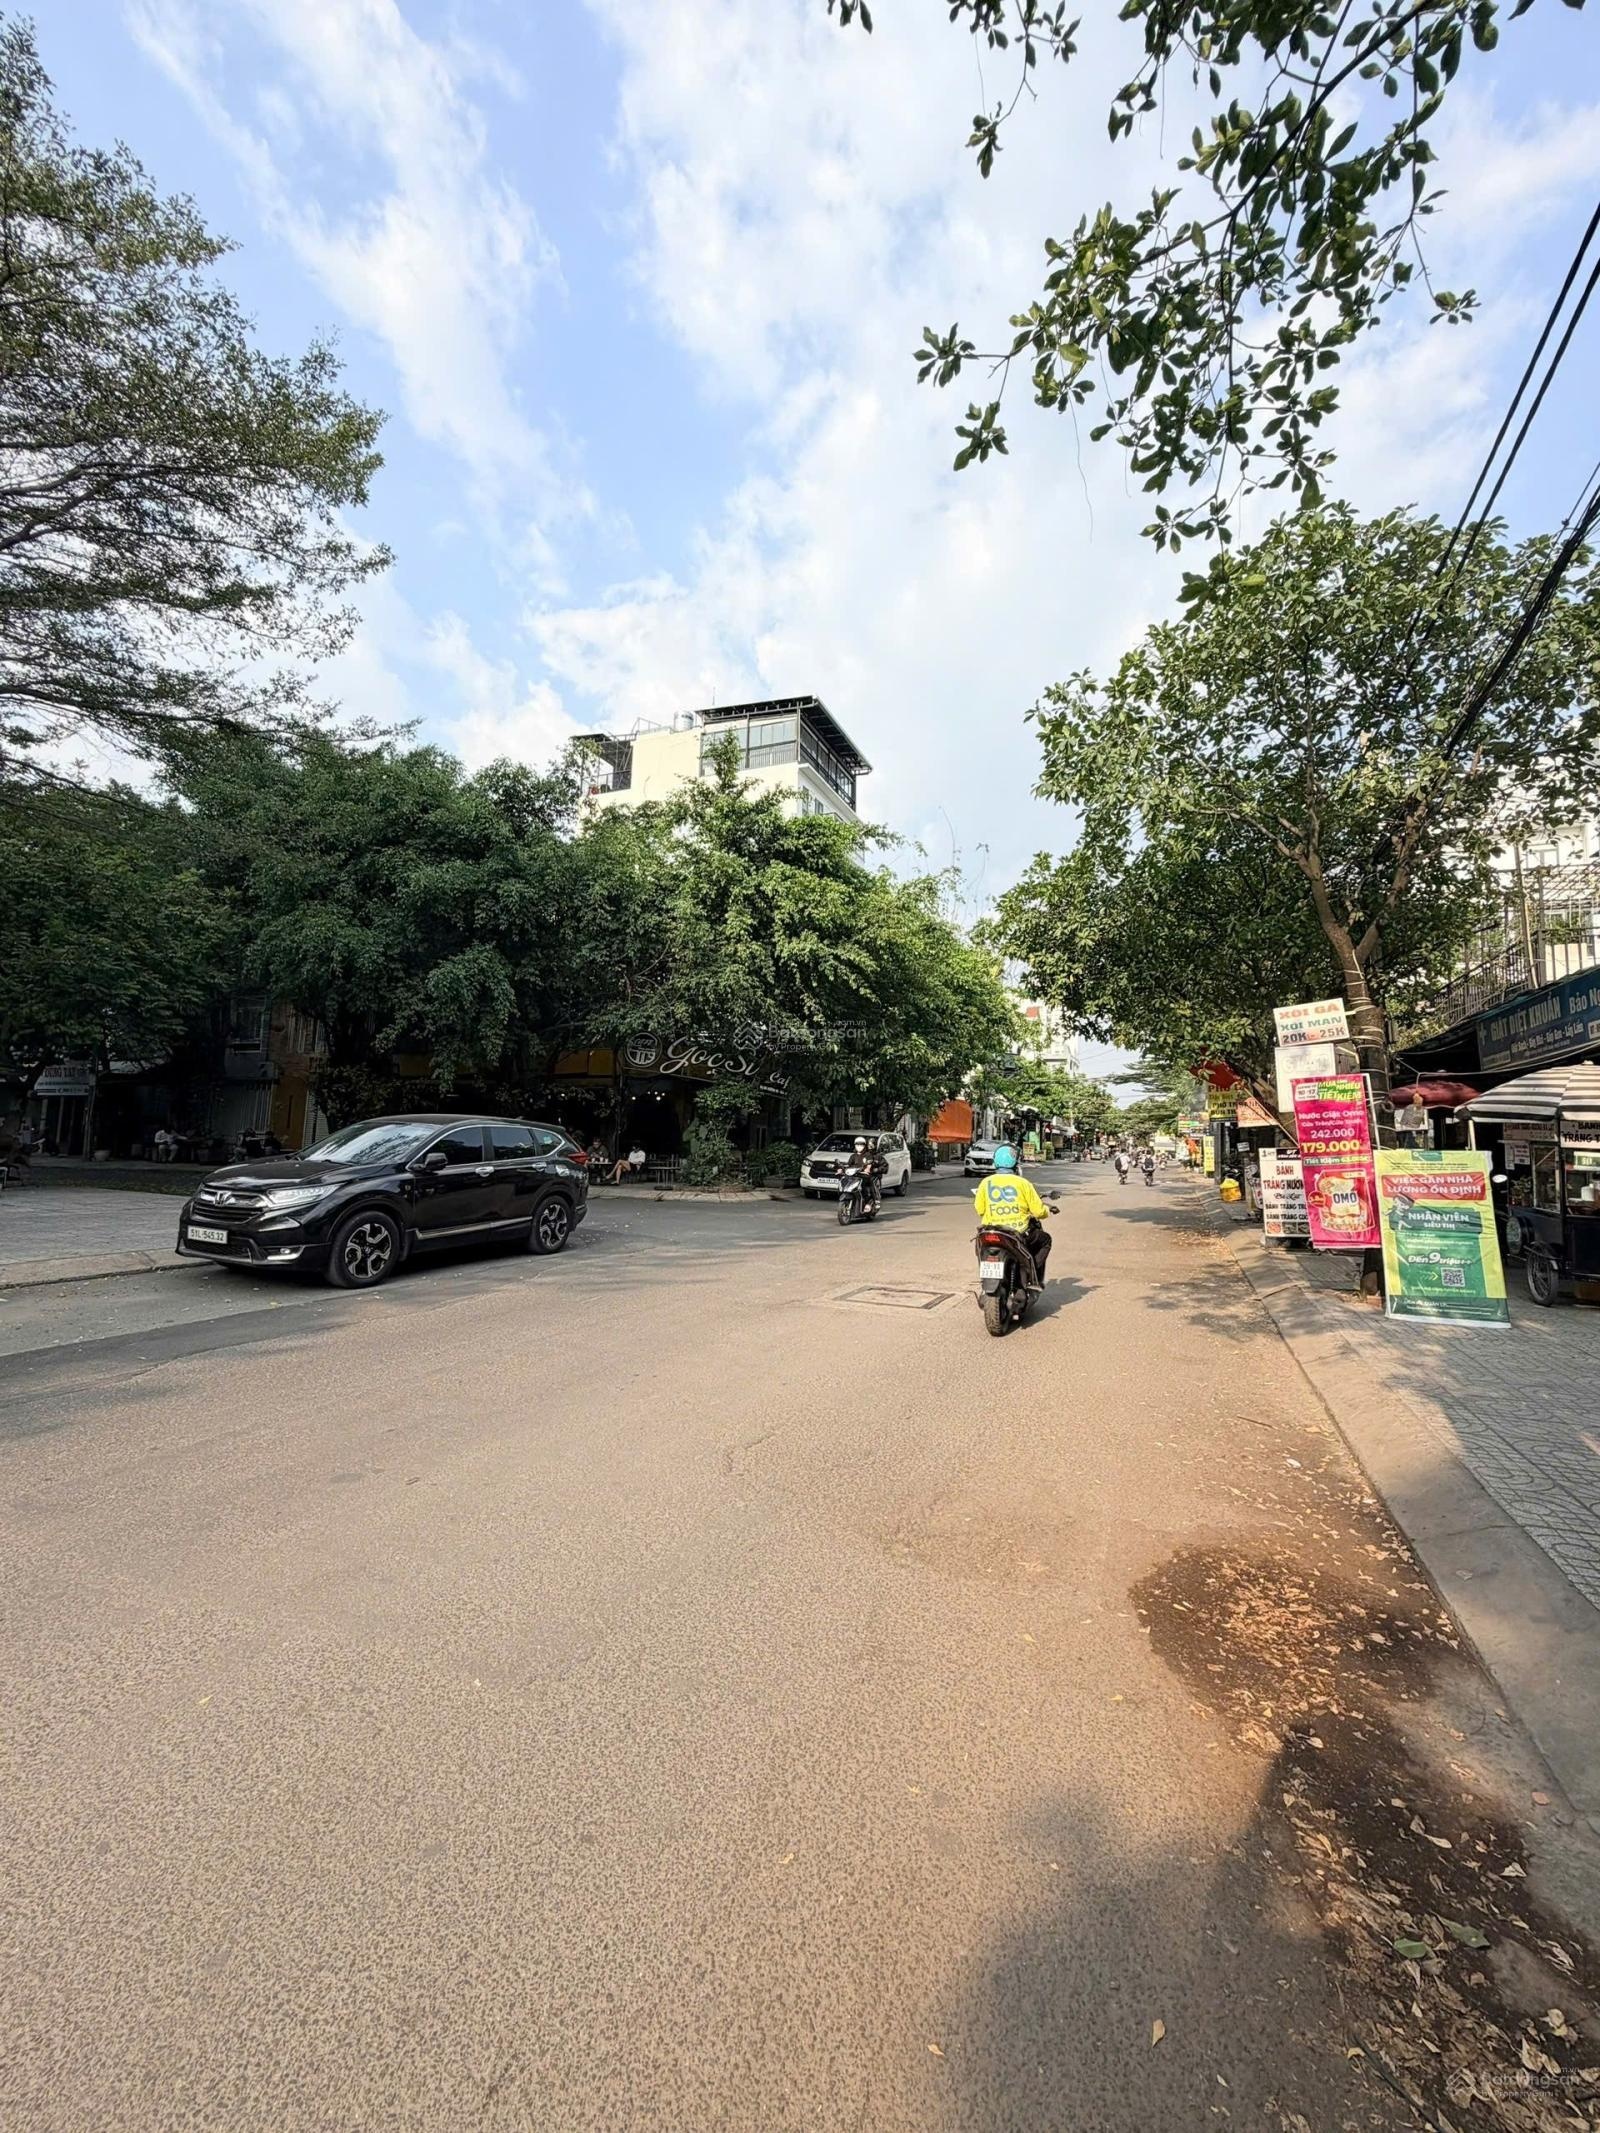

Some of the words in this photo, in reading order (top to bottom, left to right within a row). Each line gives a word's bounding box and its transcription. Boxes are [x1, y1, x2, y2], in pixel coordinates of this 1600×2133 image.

[1569, 992, 1587, 1014] Bảo
[1282, 1032, 1307, 1044] 20K
[1320, 1027, 1345, 1038] 25K
[1310, 1128, 1355, 1139] 242.000
[1301, 1139, 1361, 1153] 179.000
[988, 1180, 1018, 1202] be
[1449, 1185, 1481, 1195] ĐỊNH
[1333, 1192, 1357, 1204] OMO
[990, 1203, 1020, 1217] Food
[1408, 1211, 1442, 1221] NHÂN
[1442, 1211, 1470, 1222] VIÊN
